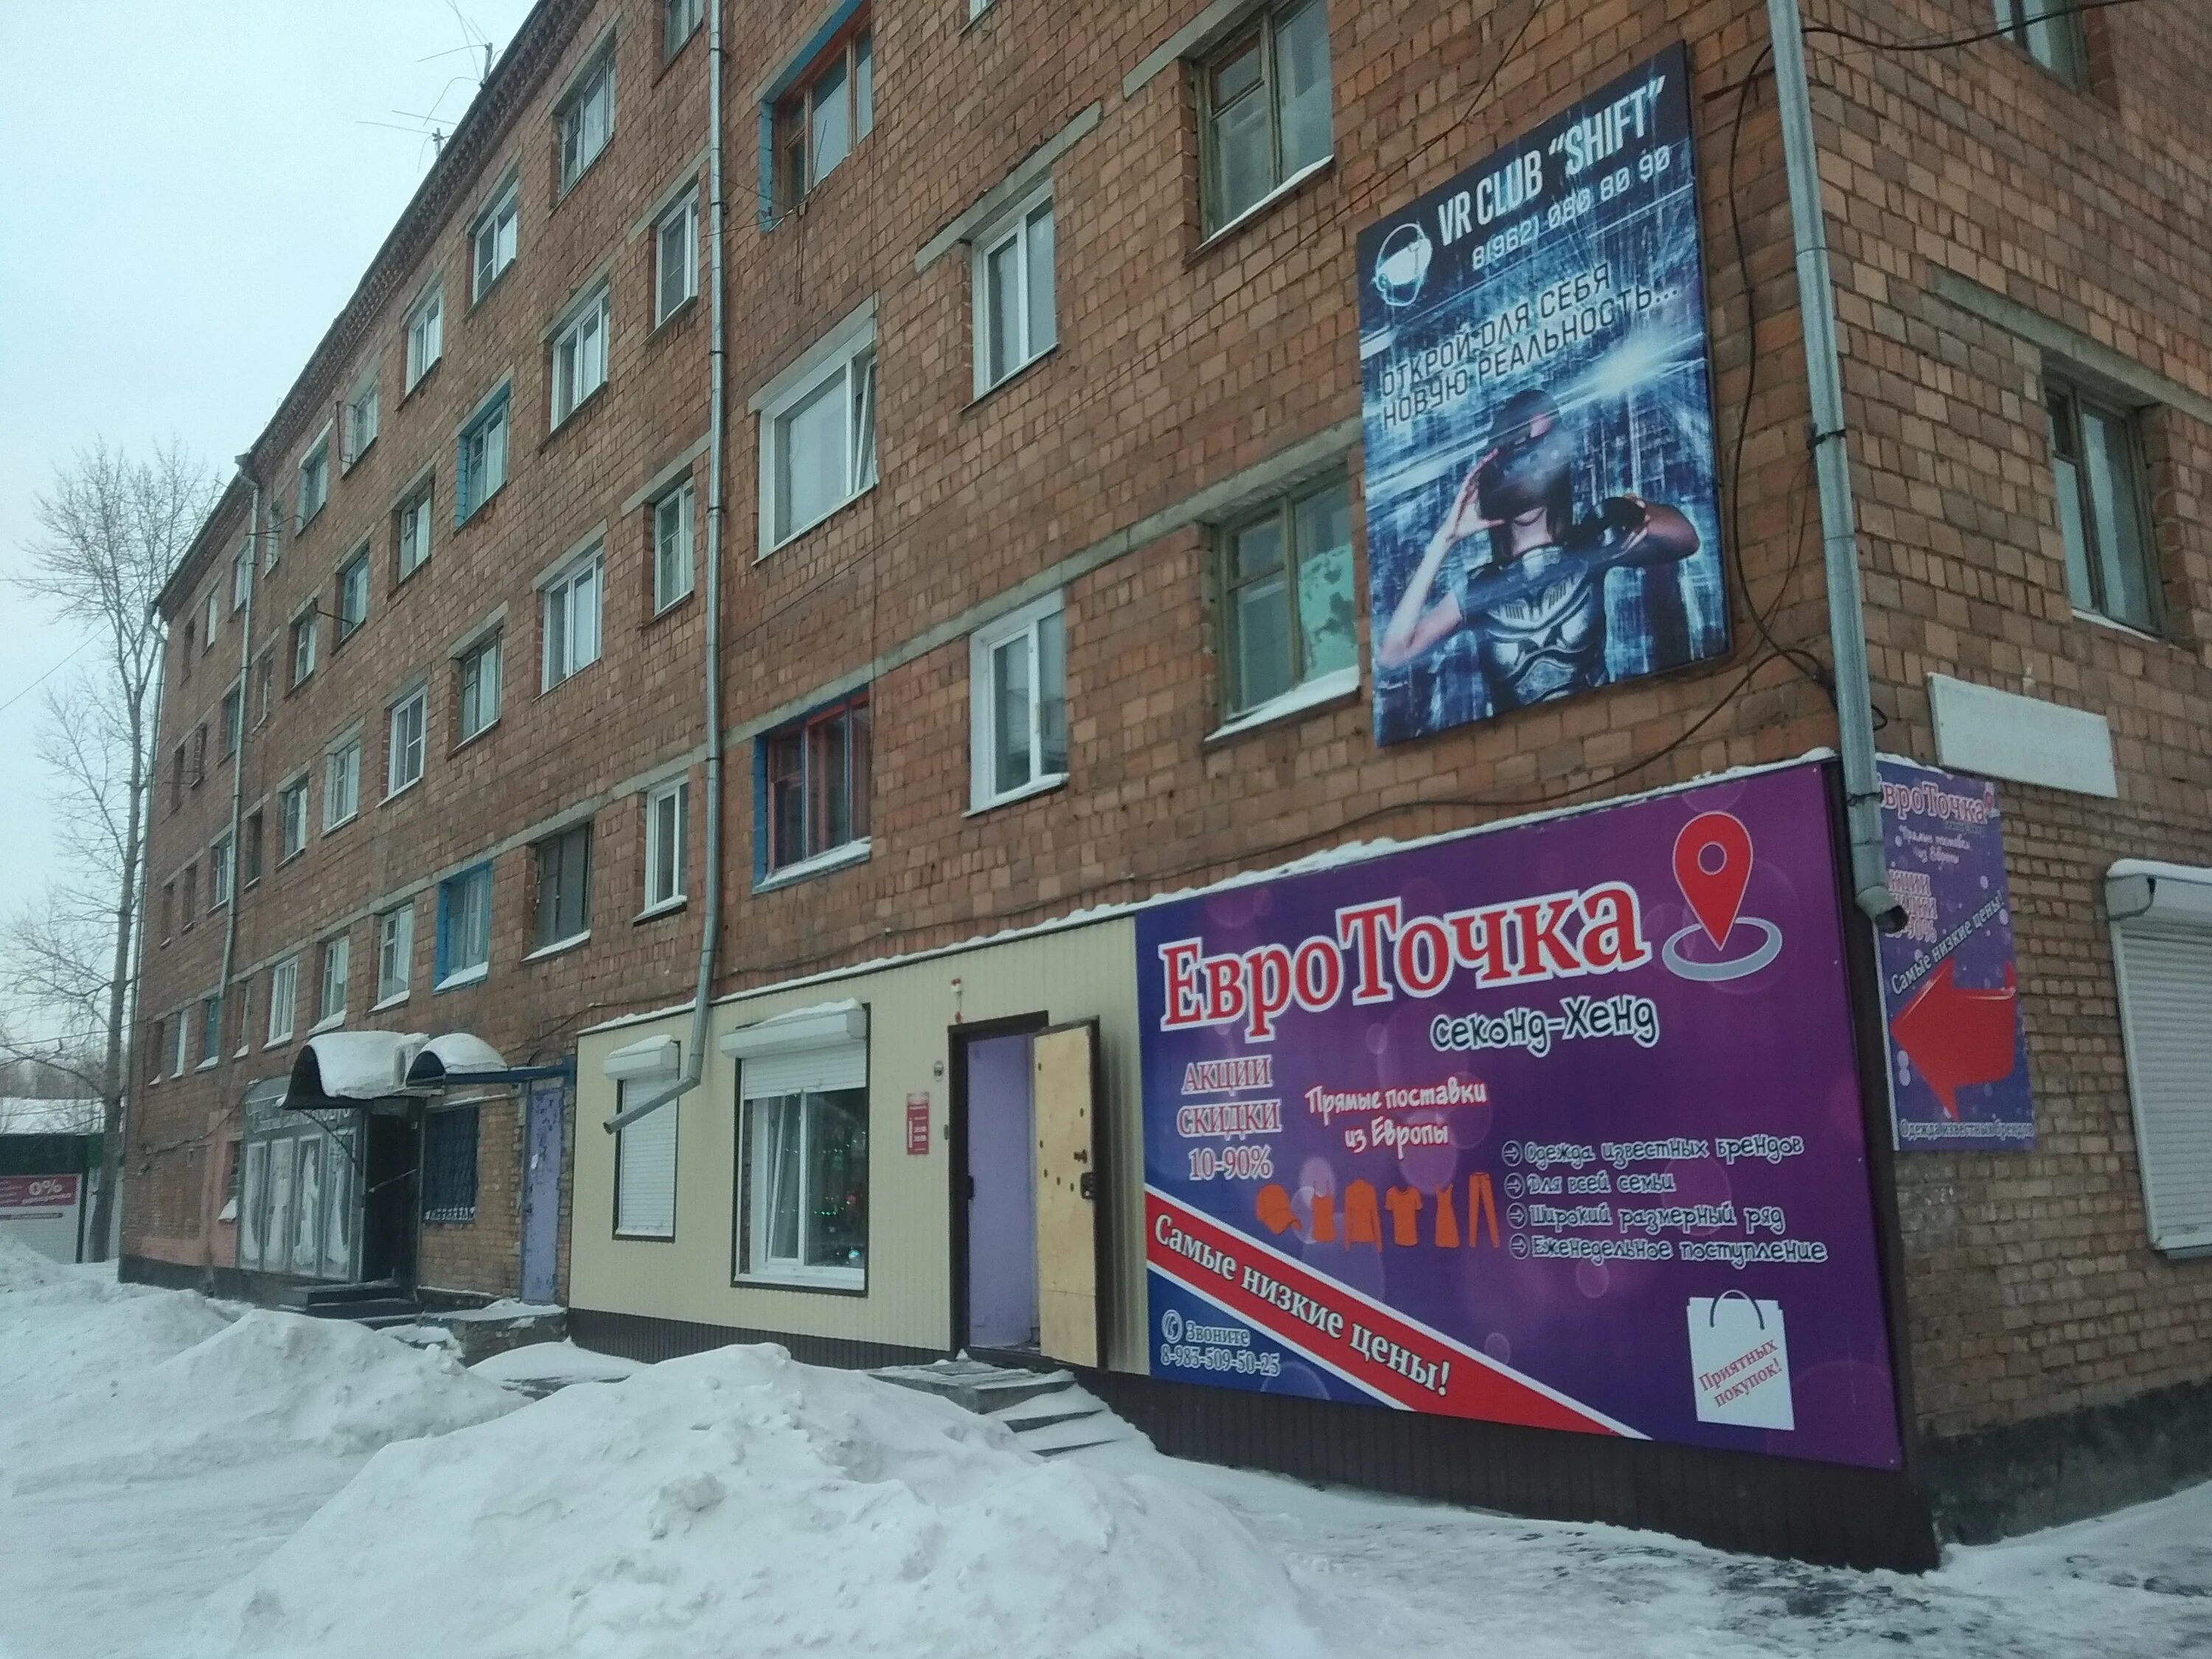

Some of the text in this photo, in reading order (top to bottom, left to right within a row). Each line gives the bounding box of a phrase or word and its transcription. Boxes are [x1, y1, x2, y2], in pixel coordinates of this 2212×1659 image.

[1438, 191, 1472, 246] VR
[1477, 150, 1543, 225] CLUB
[1472, 215, 1539, 271] 8(962)
[1600, 167, 1630, 201] 80
[1638, 145, 1671, 182] 90
[1382, 263, 1610, 396] ОТКРОЙ ДЛЯ СЕБЯ
[1385, 369, 1467, 430] НОВУЮ
[1879, 779, 1989, 824] вроТочка
[1888, 869, 1932, 897] КЦИИ
[1158, 880, 1651, 1043] ЕвроТочка
[1891, 890, 2005, 995] Самые низкие цены!
[1180, 1054, 1274, 1096] АКЦИИ
[1177, 1099, 1282, 1140] СКИДКИ
[1305, 1077, 1487, 1126] Прямые поставки
[1345, 1116, 1449, 1160] из Европы
[1524, 1141, 1596, 1169] Одежда
[1601, 1137, 1710, 1169] известных
[1188, 1144, 1273, 1180] 10-90%
[1527, 1169, 1677, 1194] Для всей семьи
[29, 1179, 63, 1196] 0%
[1529, 1200, 1786, 1235] Широкий размерный ряд
[1531, 1235, 1829, 1270] Еженедельное поступление
[1155, 1214, 1450, 1397] Самые низкие цены!
[1185, 1320, 1251, 1347] Звоните
[1699, 1339, 1778, 1391] Приятных
[1714, 1357, 1782, 1408] покупок!
